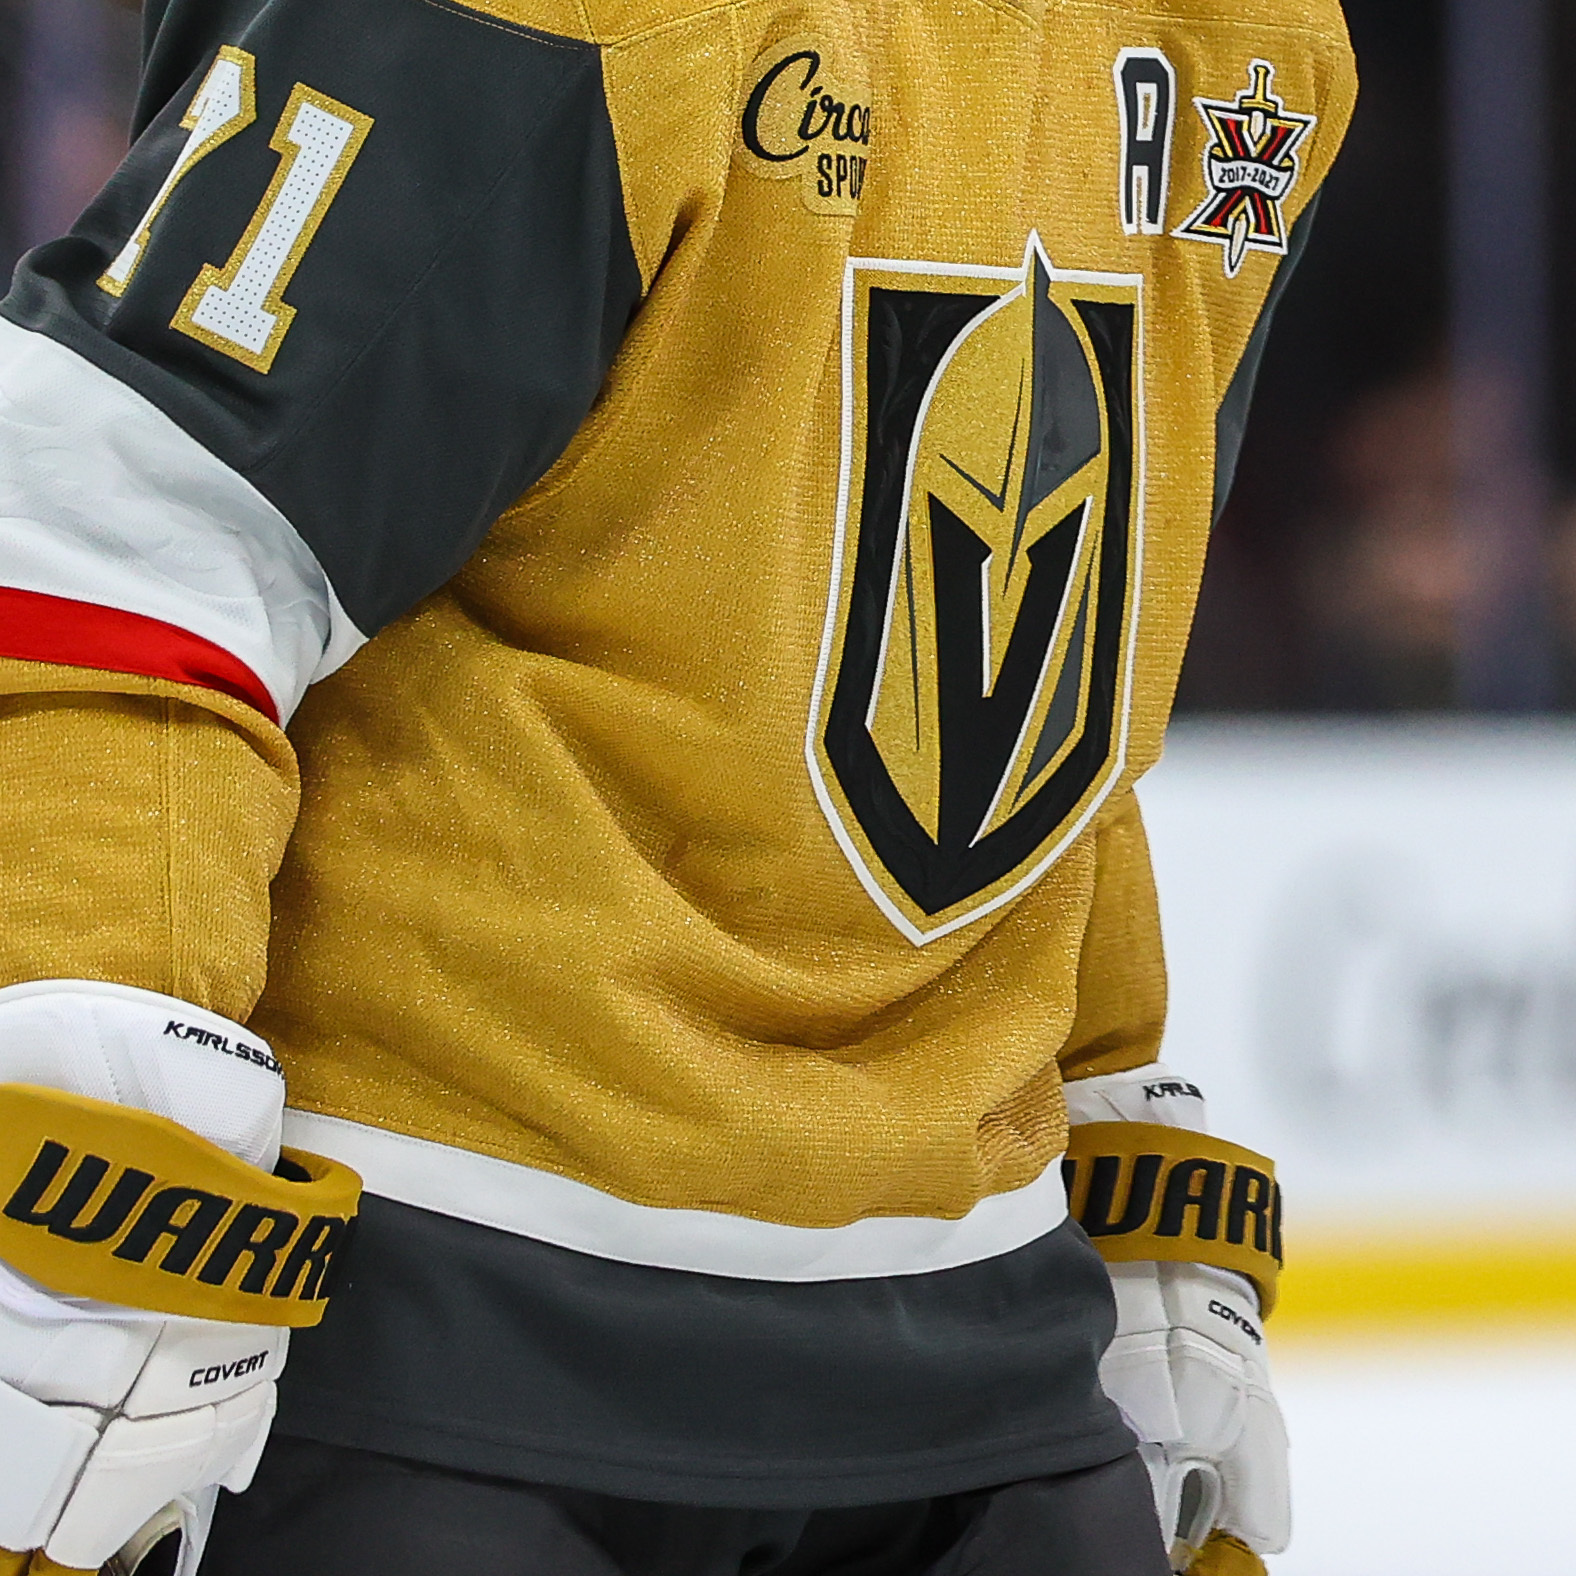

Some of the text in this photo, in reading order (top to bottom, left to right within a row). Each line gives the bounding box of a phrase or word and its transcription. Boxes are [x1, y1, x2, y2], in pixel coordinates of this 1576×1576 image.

[1112, 46, 1177, 236] A
[1218, 165, 1280, 191] 2017-2027
[97, 44, 375, 375] 71
[189, 1350, 269, 1388] COVERT
